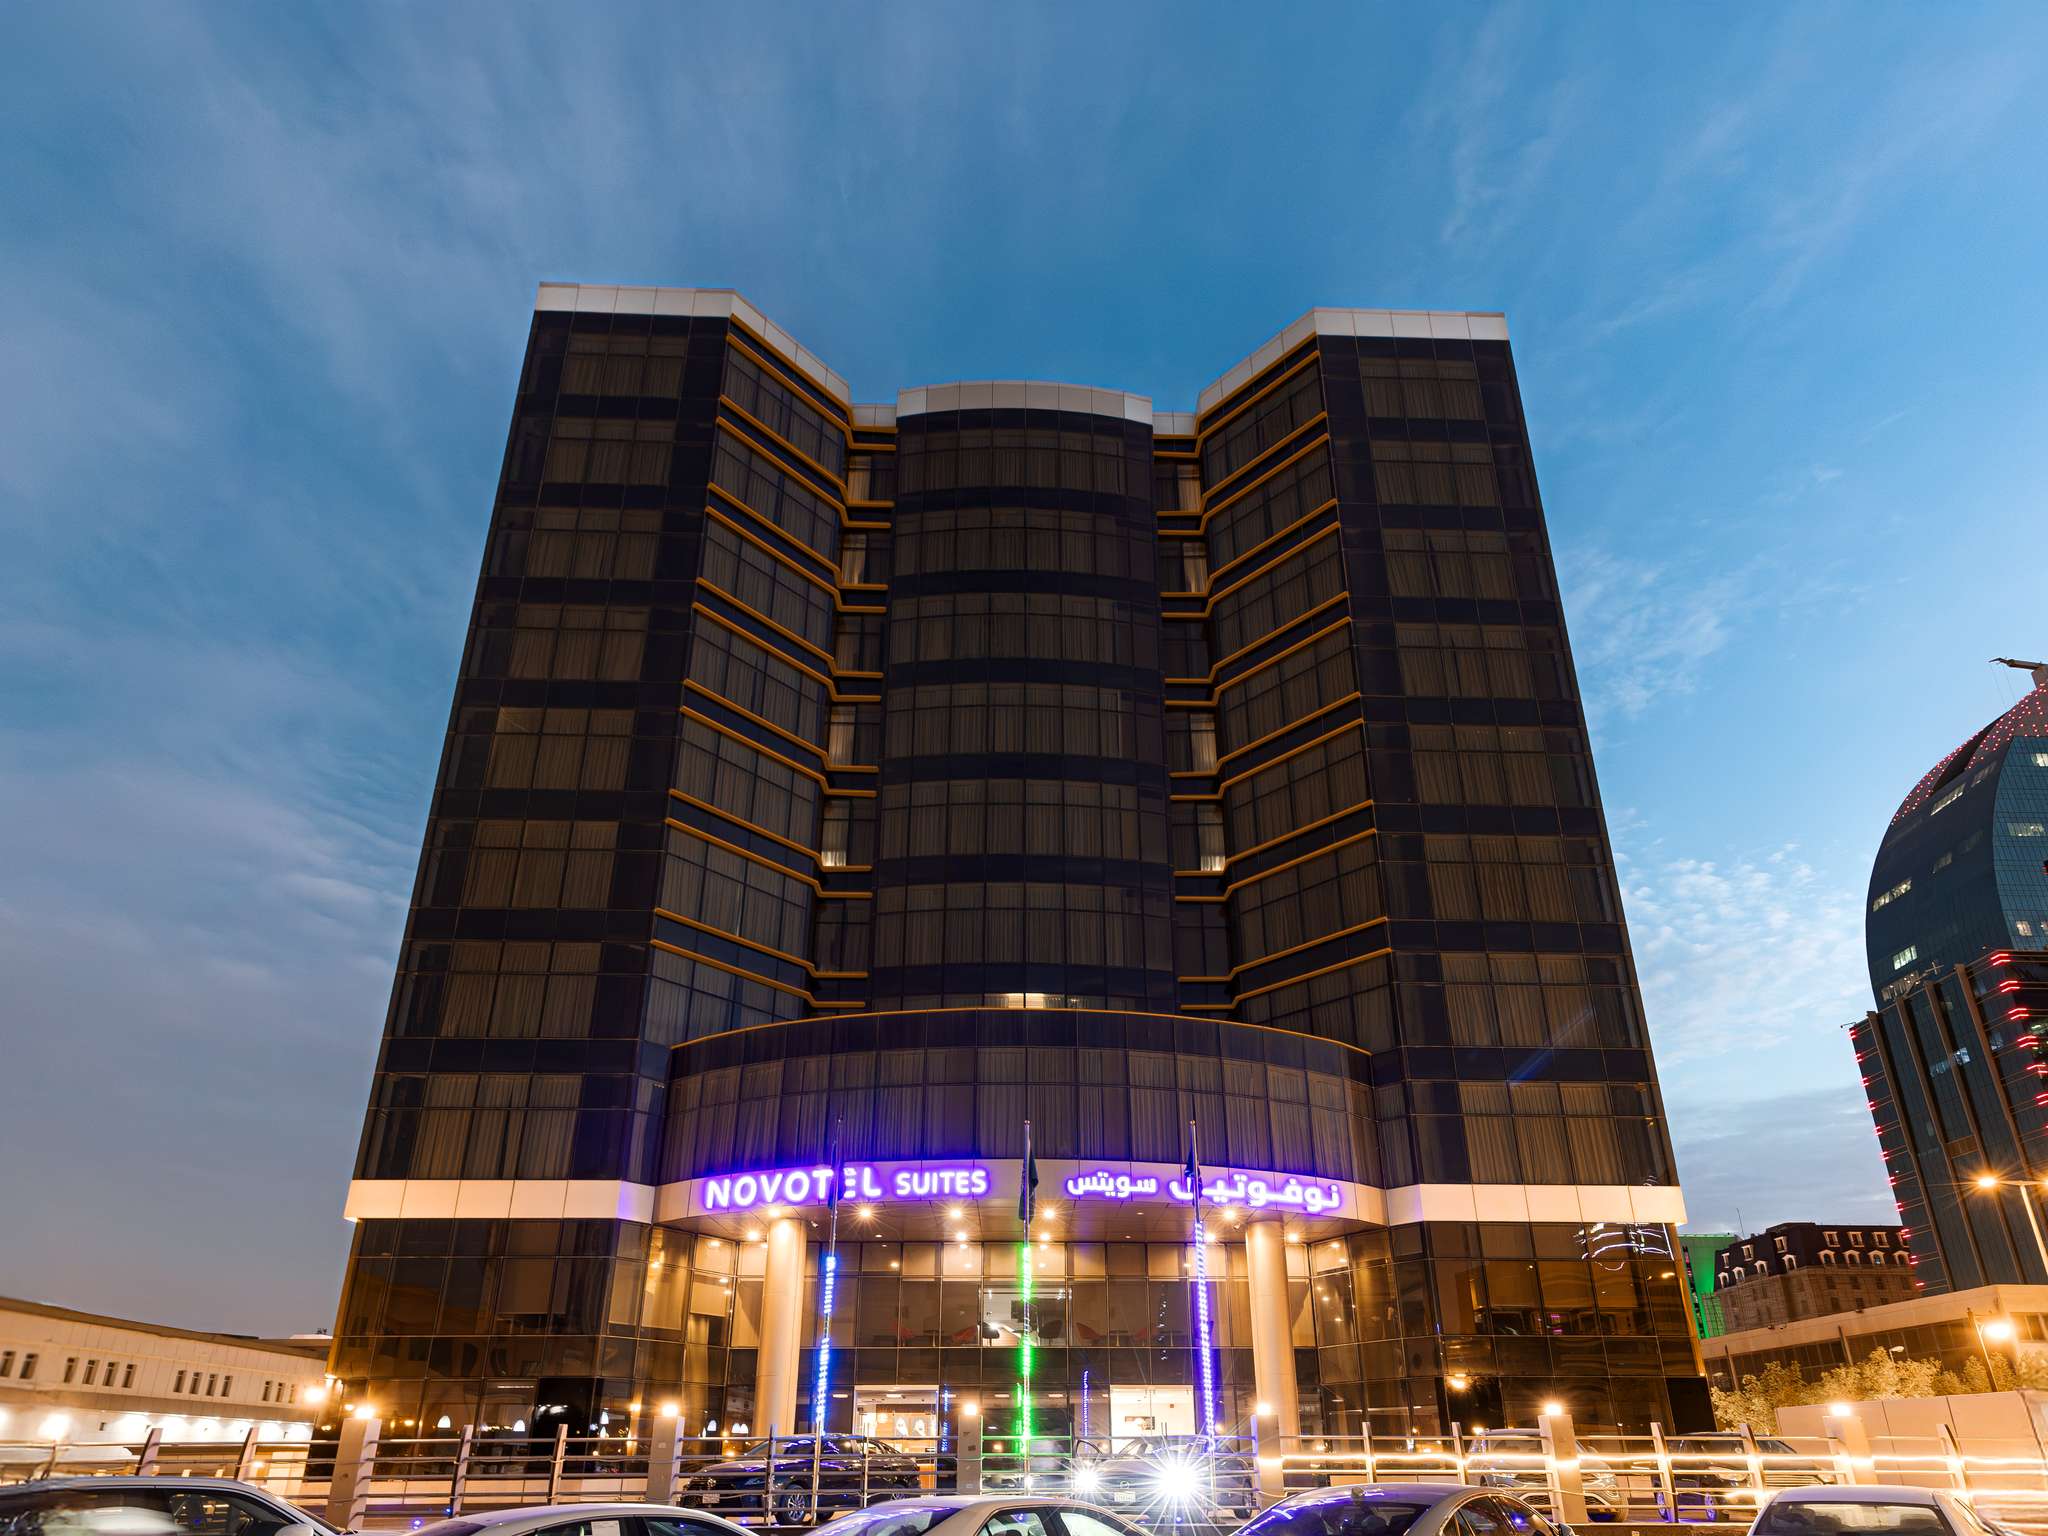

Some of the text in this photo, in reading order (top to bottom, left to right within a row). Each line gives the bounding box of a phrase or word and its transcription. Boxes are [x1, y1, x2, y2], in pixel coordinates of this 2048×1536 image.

[706, 1166, 987, 1209] NOVOTEL SUITES
[1066, 1171, 1157, 1198] سويتس
